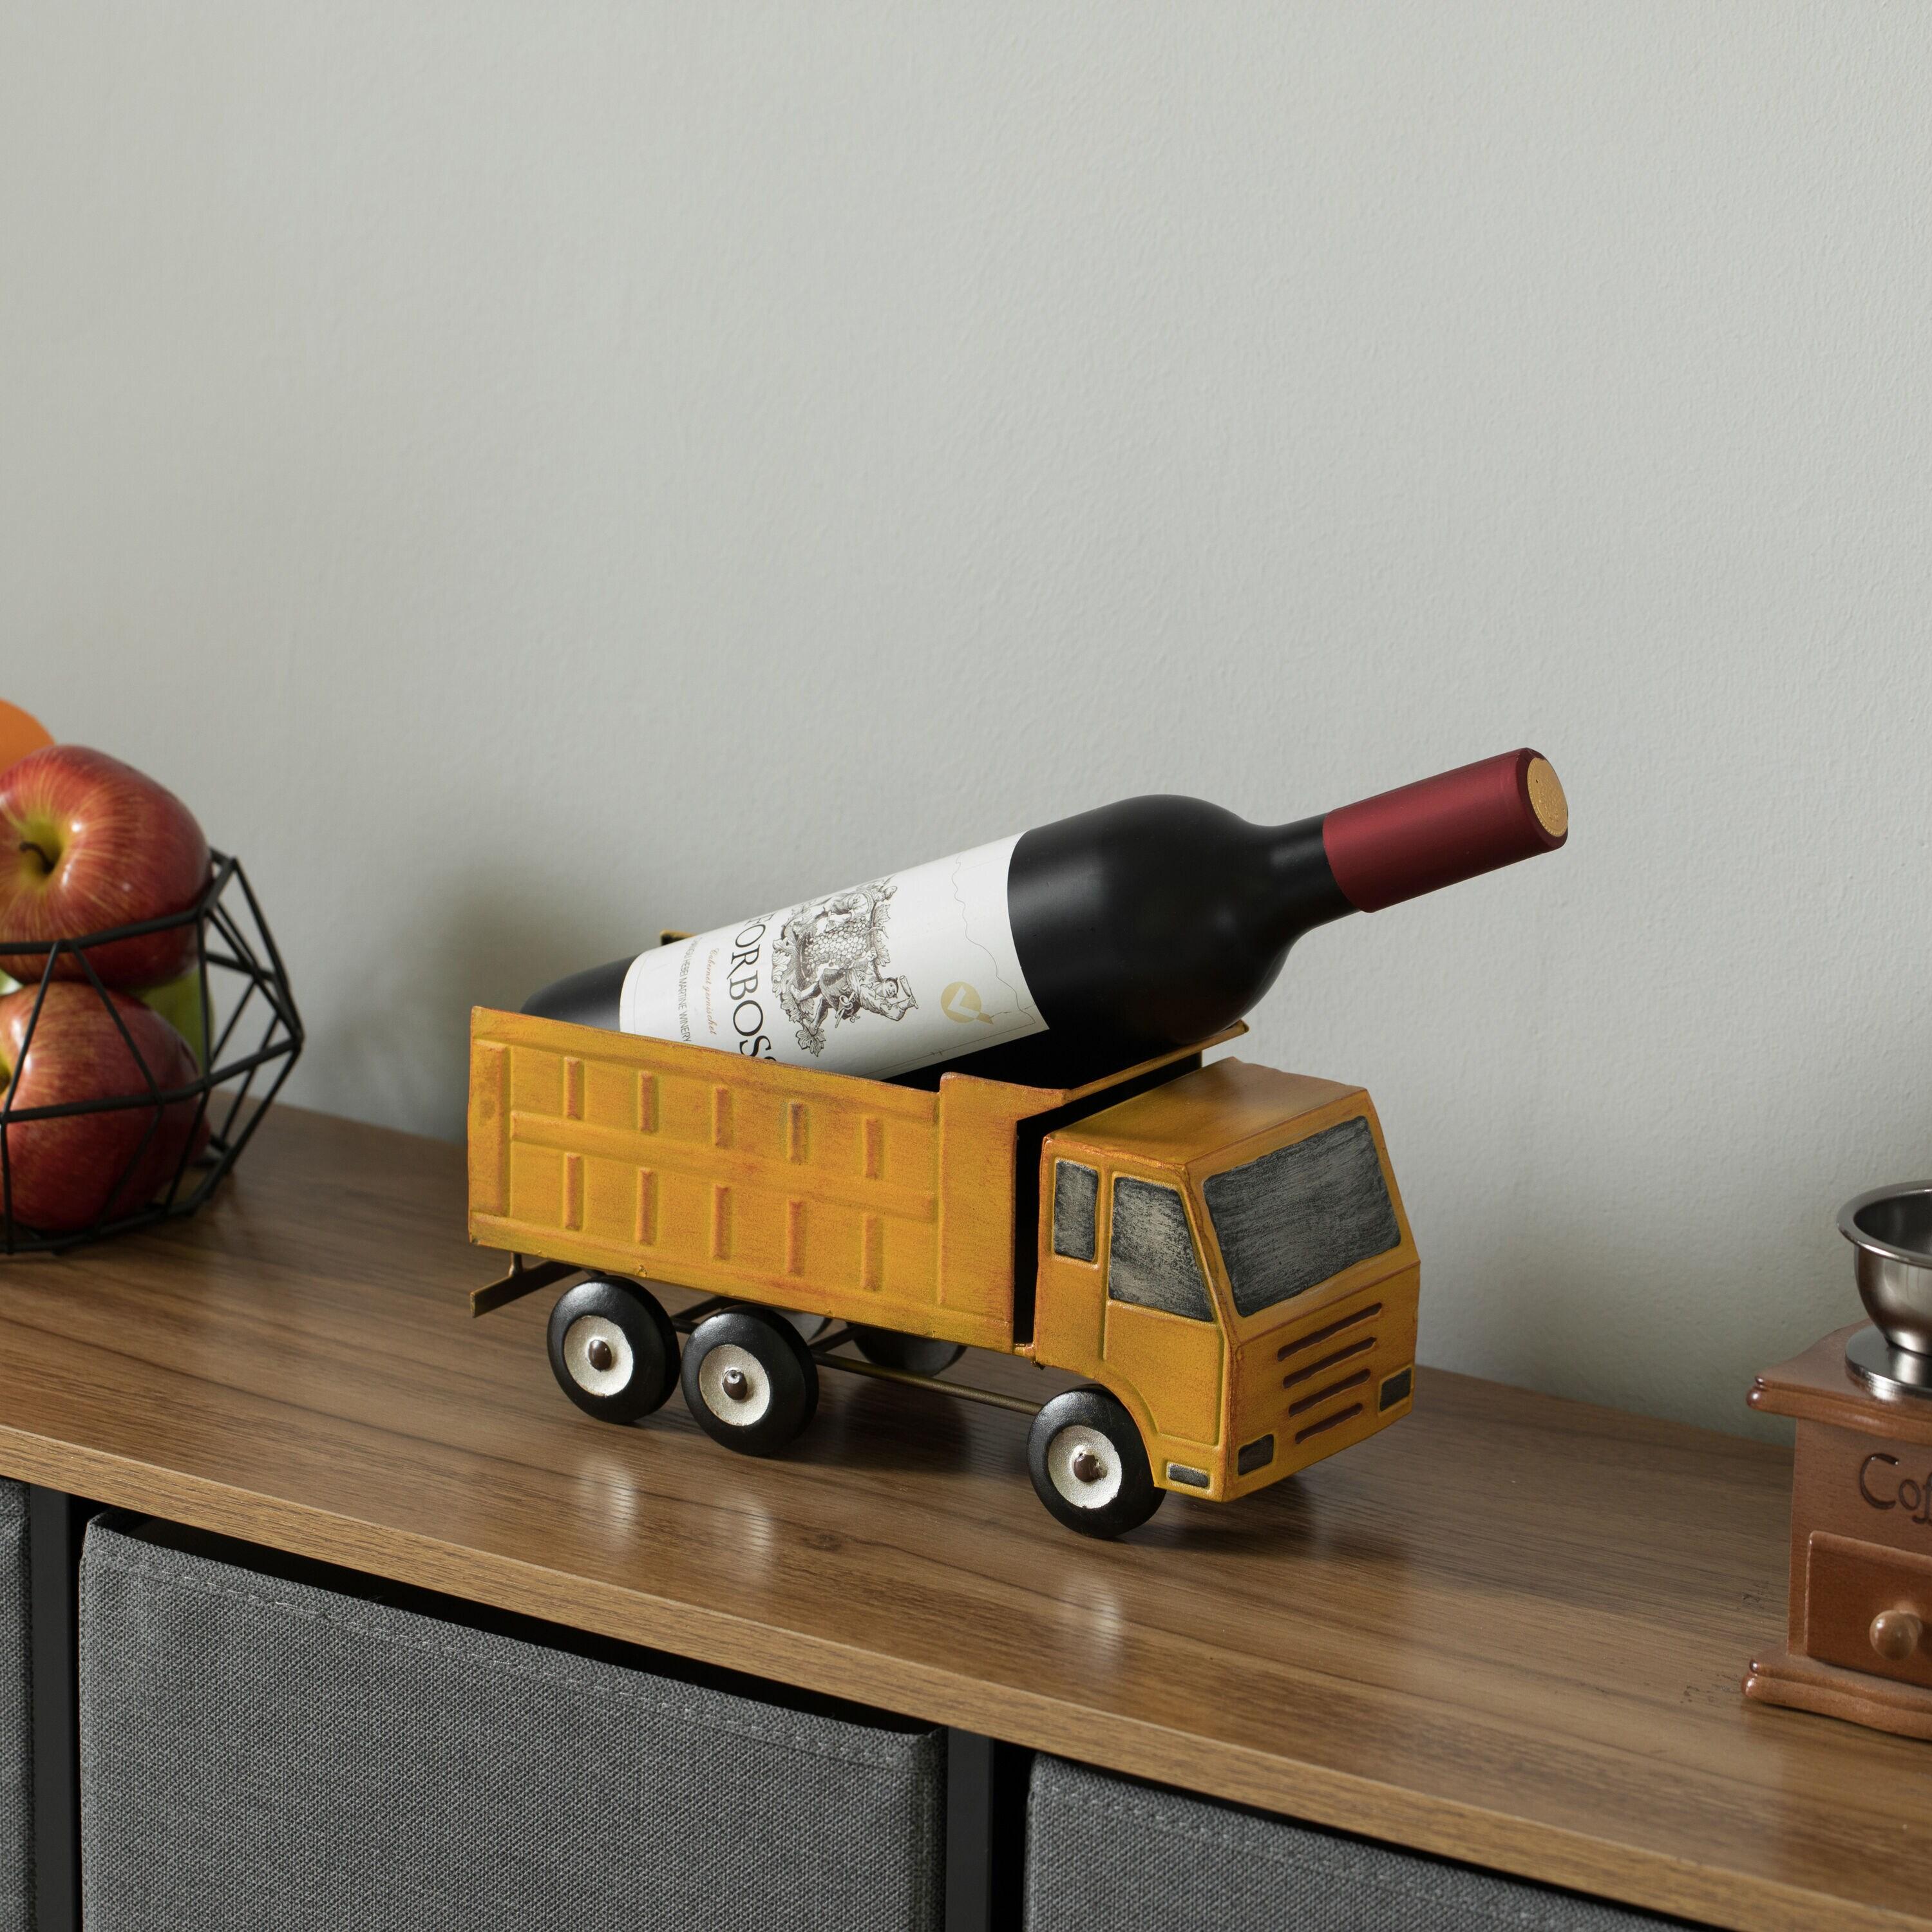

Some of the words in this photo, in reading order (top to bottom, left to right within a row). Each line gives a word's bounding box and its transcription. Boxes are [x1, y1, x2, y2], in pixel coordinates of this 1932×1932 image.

[679, 958, 691, 977] HEBEI
[677, 977, 688, 1010] MARTINE
[726, 912, 777, 1062] FORBOS
[679, 1010, 692, 1042] WINERY
